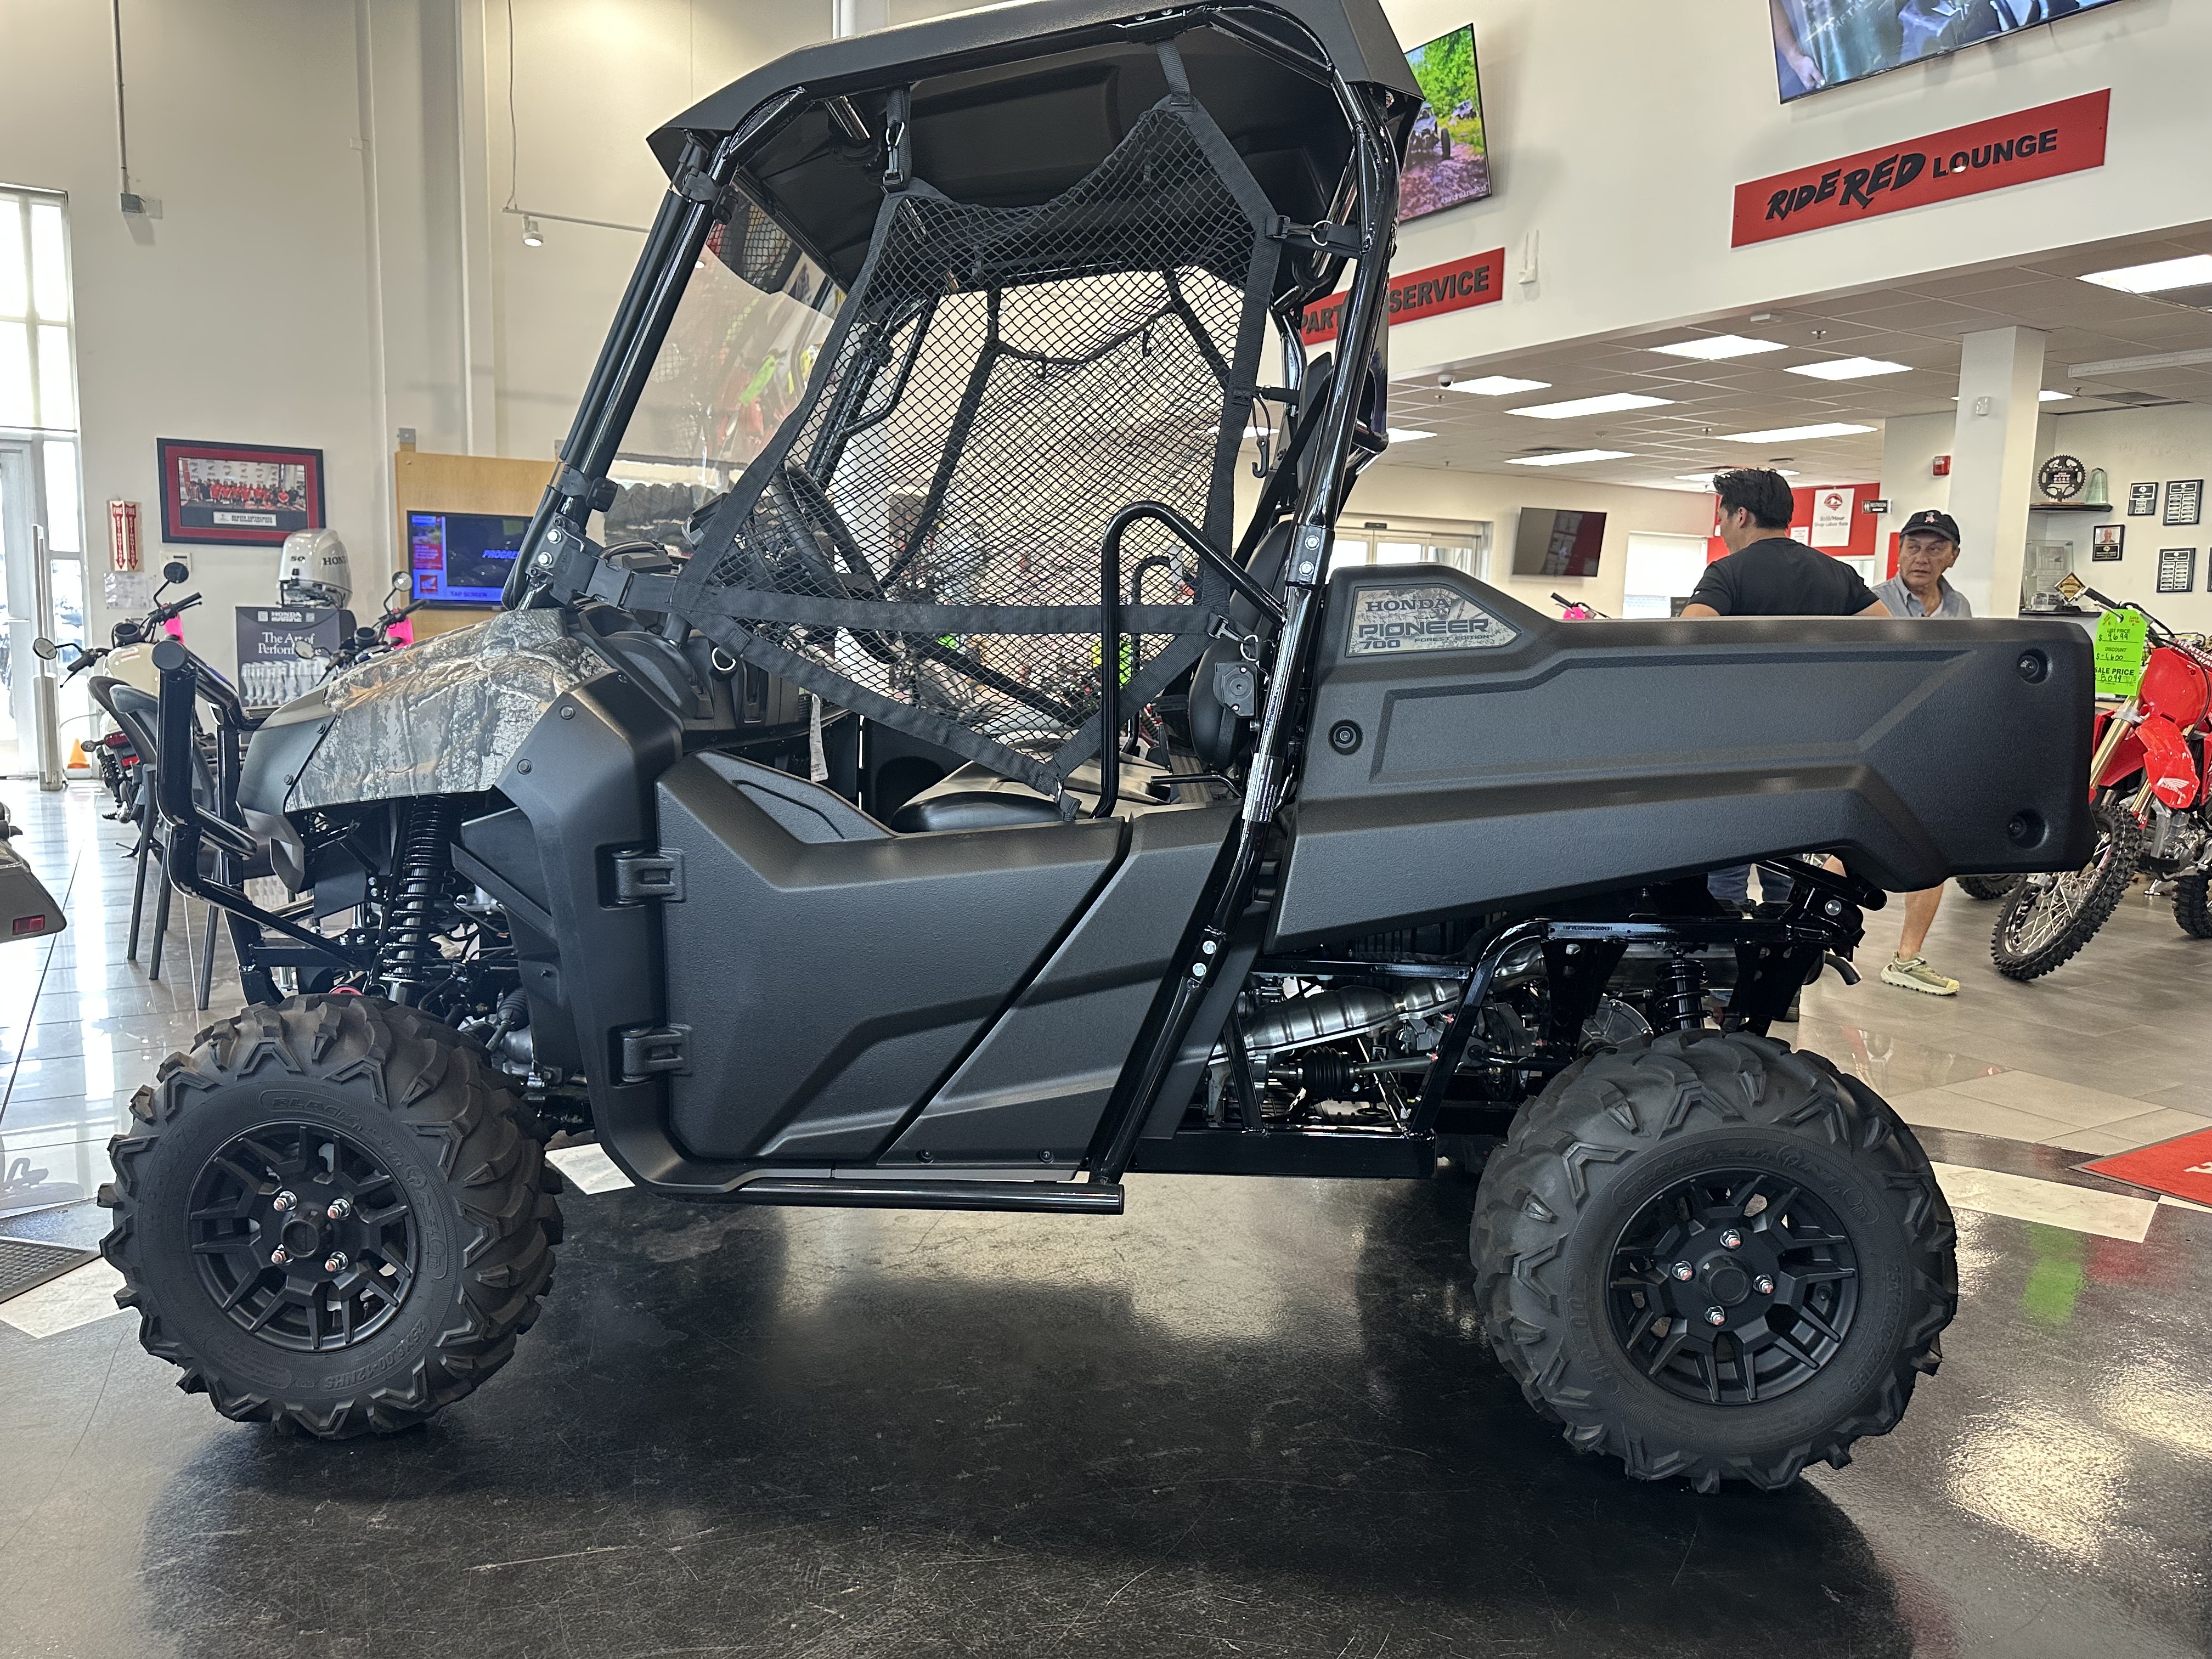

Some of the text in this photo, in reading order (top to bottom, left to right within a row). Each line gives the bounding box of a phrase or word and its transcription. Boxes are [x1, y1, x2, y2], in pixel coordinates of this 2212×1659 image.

[1765, 129, 2058, 220] RIDE RED LOUNGE
[1389, 266, 1489, 313] SERVICE
[1365, 599, 1452, 612] HONDA
[1359, 619, 1489, 638] PIONEER
[262, 631, 283, 644] The
[1359, 640, 1401, 650] 700
